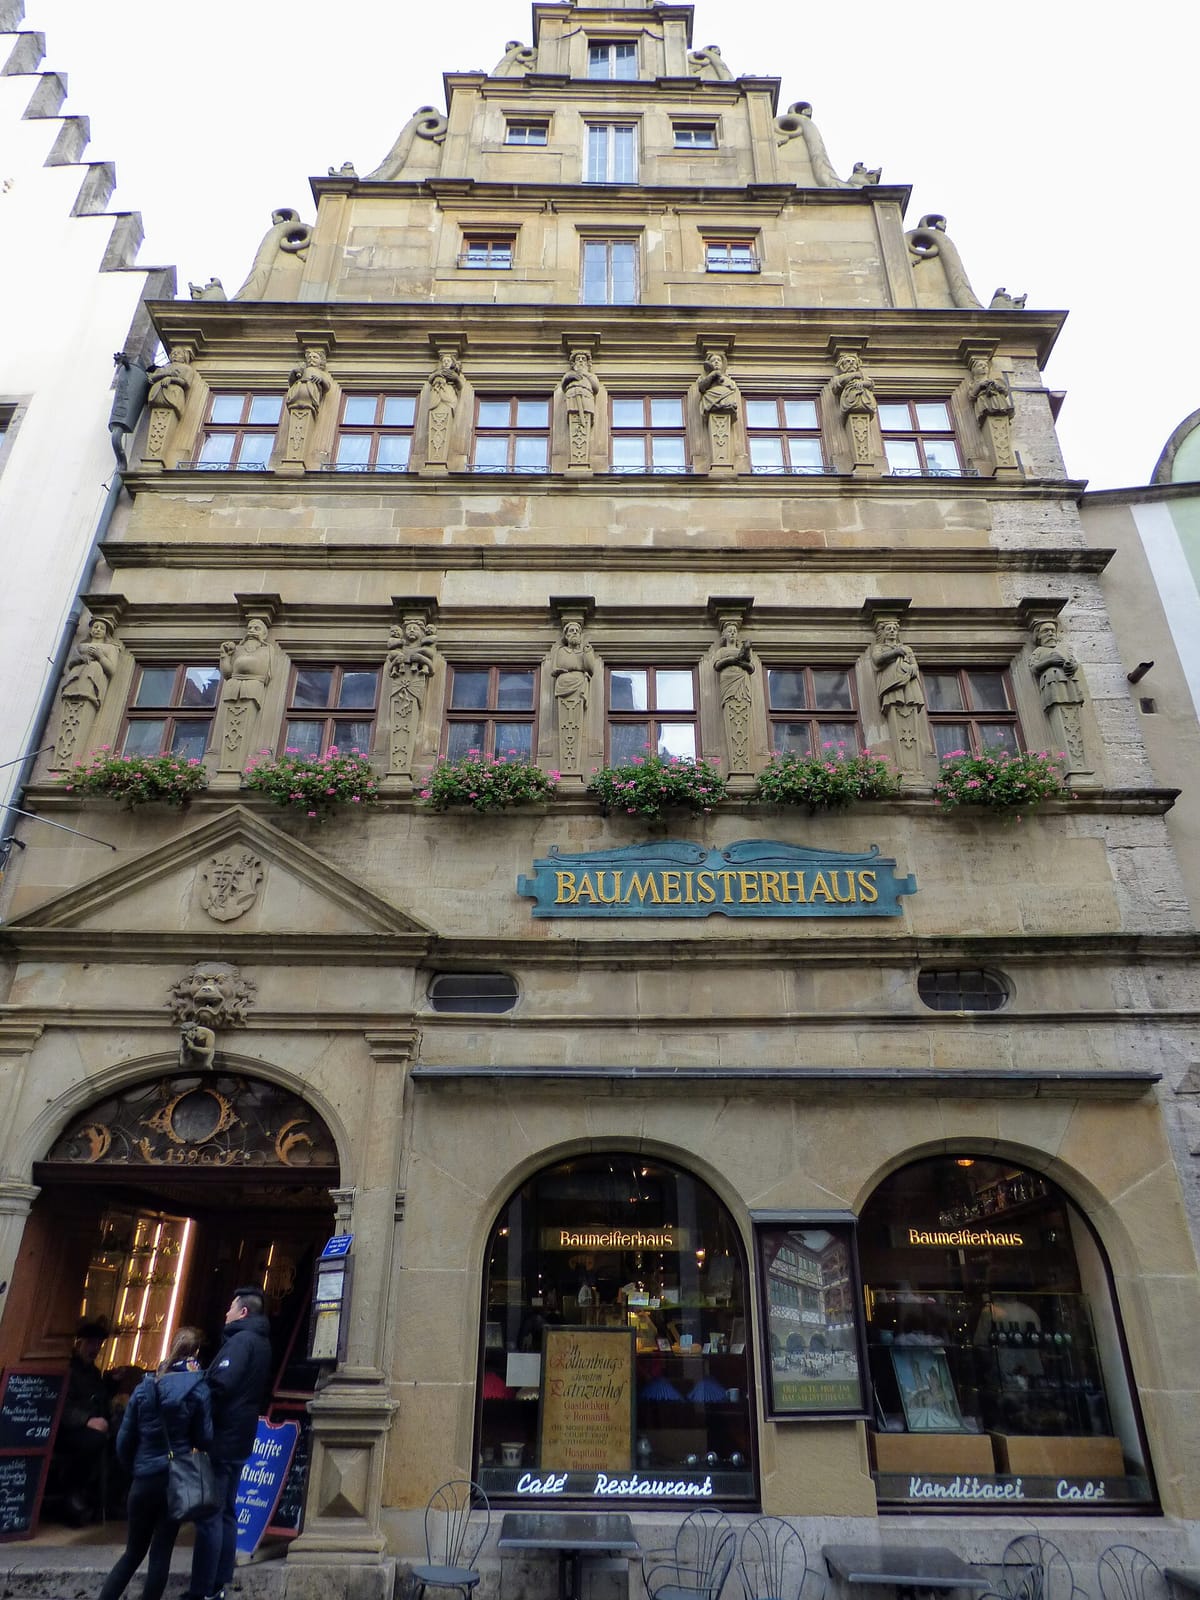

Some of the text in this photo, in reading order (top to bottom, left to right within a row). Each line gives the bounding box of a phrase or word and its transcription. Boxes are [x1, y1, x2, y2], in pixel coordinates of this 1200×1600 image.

[555, 870, 879, 904] BAUMEISTERHAUS
[550, 1351, 625, 1377] Rothenburgs
[550, 1377, 628, 1405] Patrizierhof
[251, 1437, 282, 1460] Kaffee
[240, 1464, 276, 1488] Kuchen
[516, 1472, 714, 1496] Café Restaurant
[908, 1476, 1106, 1500] Konditorei Café
[237, 1507, 252, 1525] Eis
